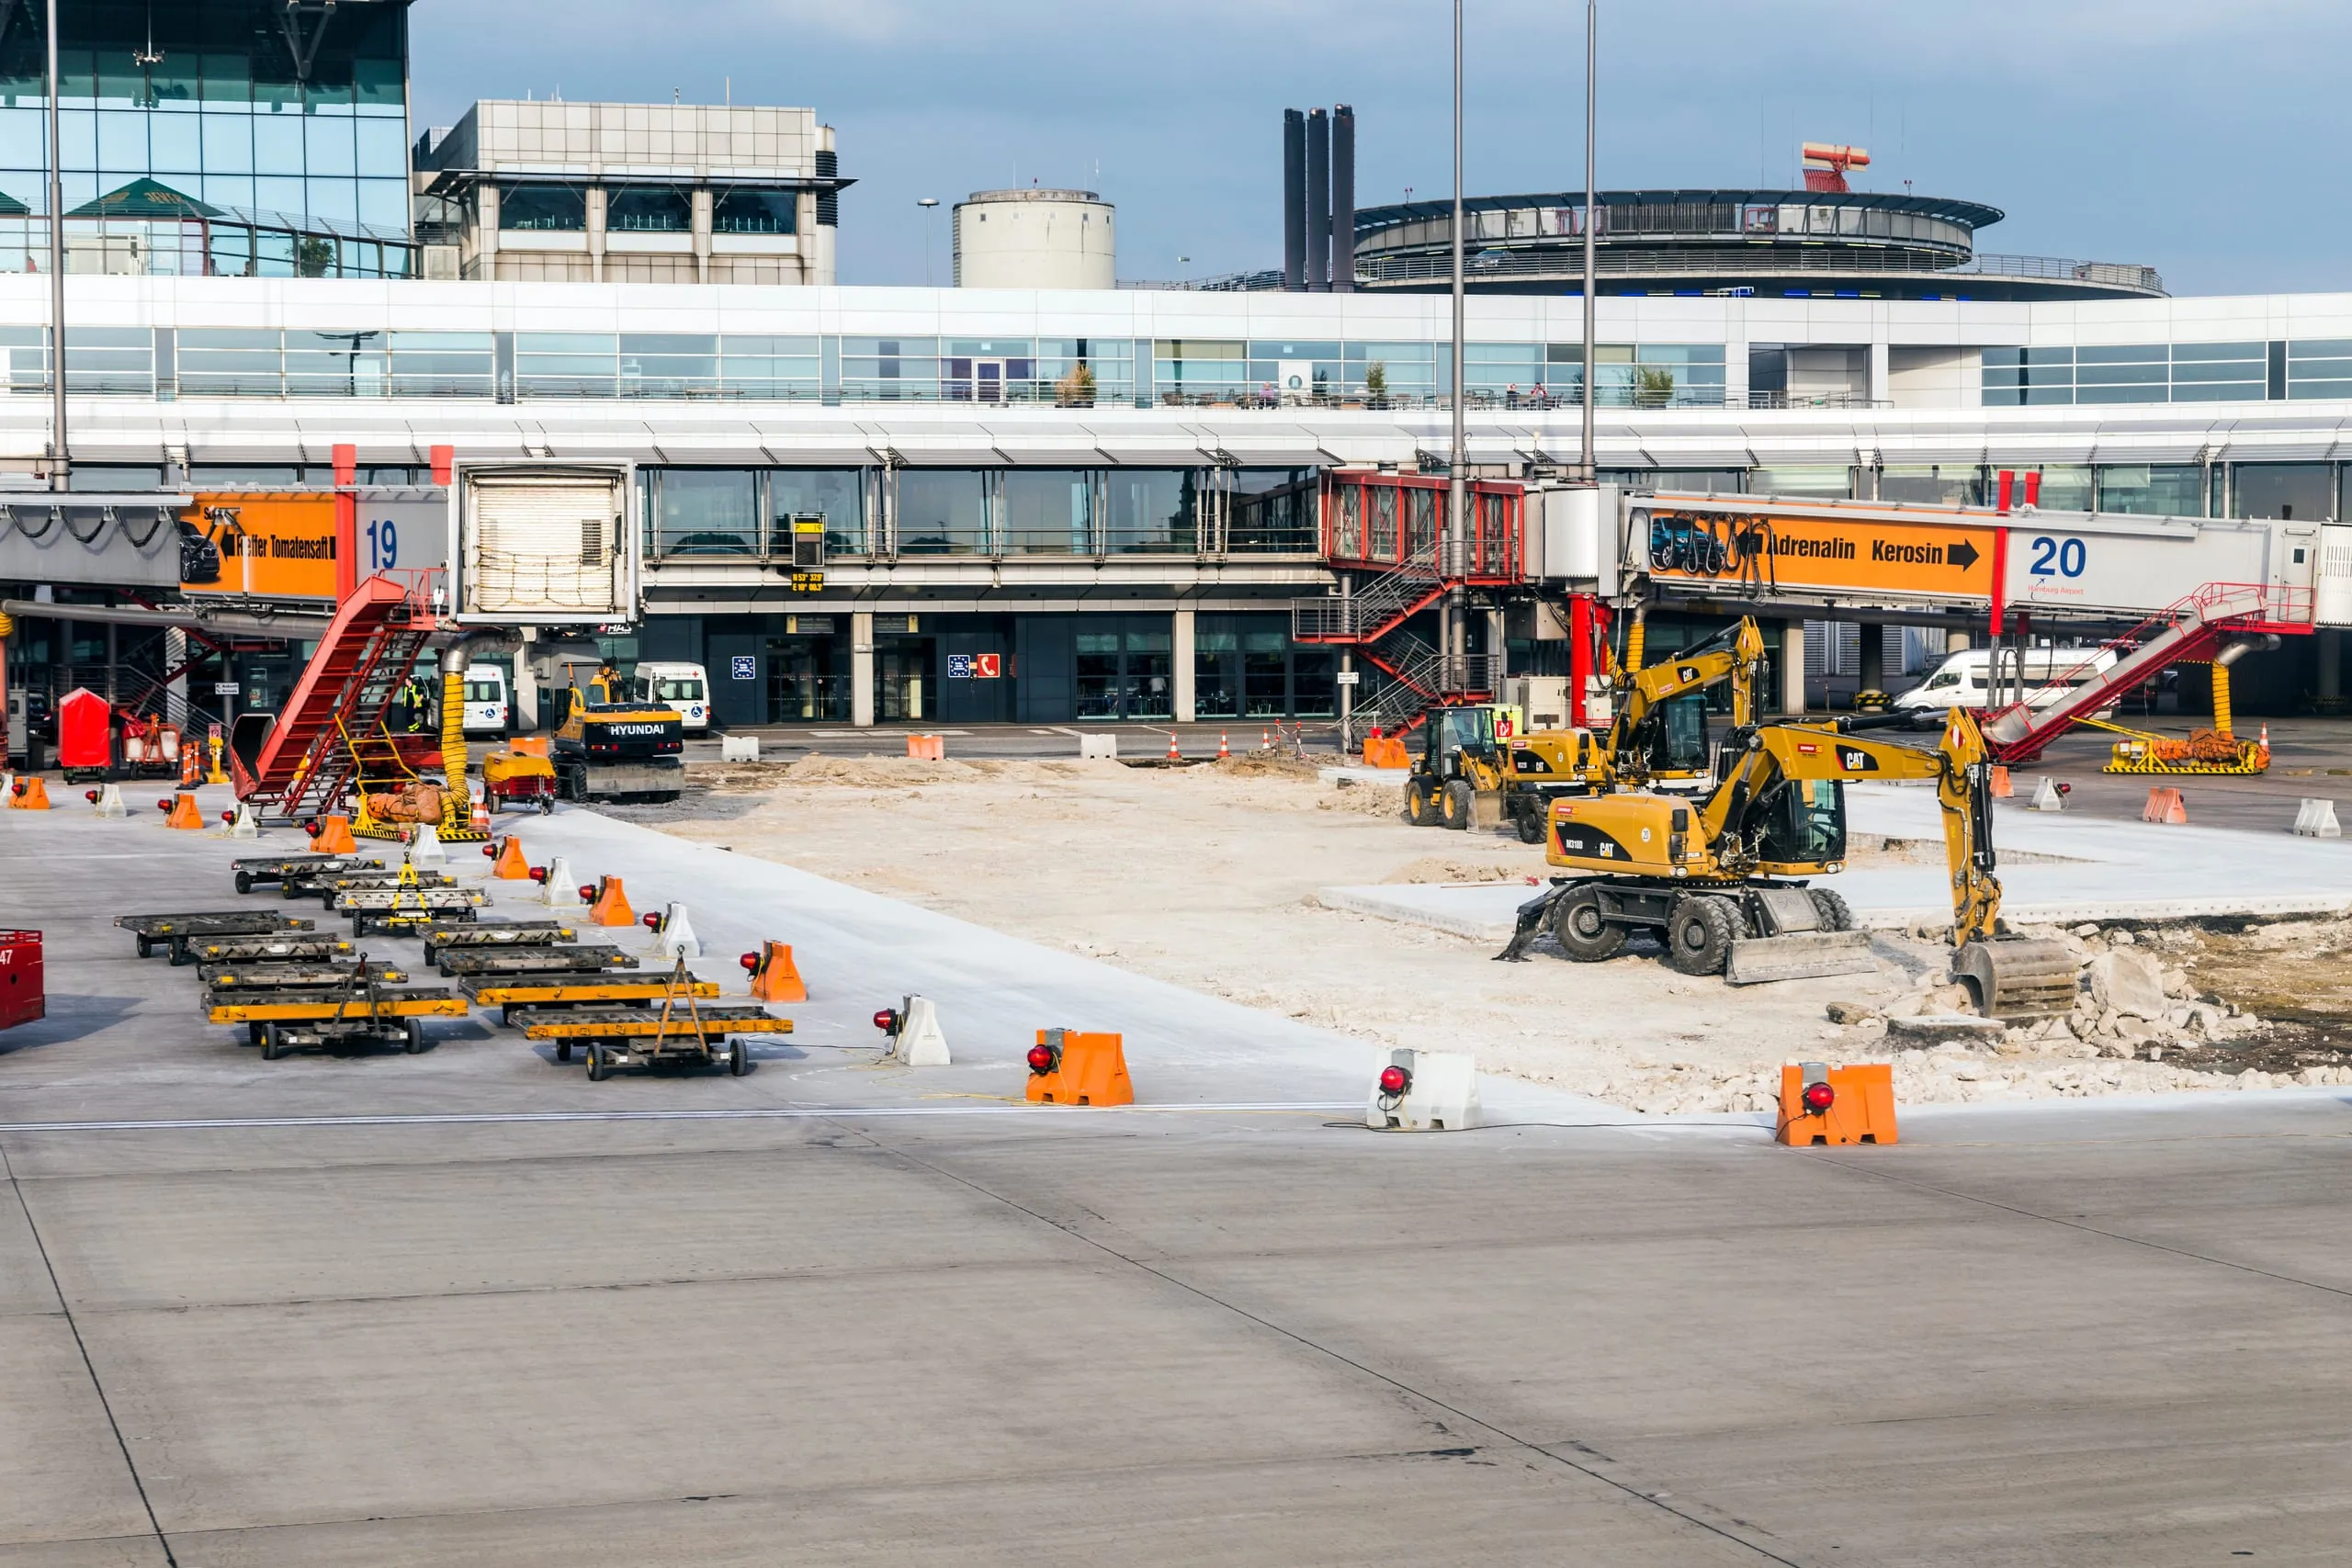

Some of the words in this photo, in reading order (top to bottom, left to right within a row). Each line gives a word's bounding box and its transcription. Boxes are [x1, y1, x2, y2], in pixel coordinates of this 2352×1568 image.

[270, 534, 328, 559] Tomatensaft
[367, 520, 397, 570] 19
[1766, 535, 1855, 559] Adrenalin
[1871, 539, 1943, 564] Kerosin
[2030, 536, 2086, 578] 20
[2028, 585, 2058, 594] Hamburg
[2061, 587, 2084, 595] Airport
[1683, 668, 1692, 682] CAT
[610, 724, 664, 735] HYUNDAI
[1847, 752, 1864, 770] CAT
[1600, 841, 1614, 857] CAT
